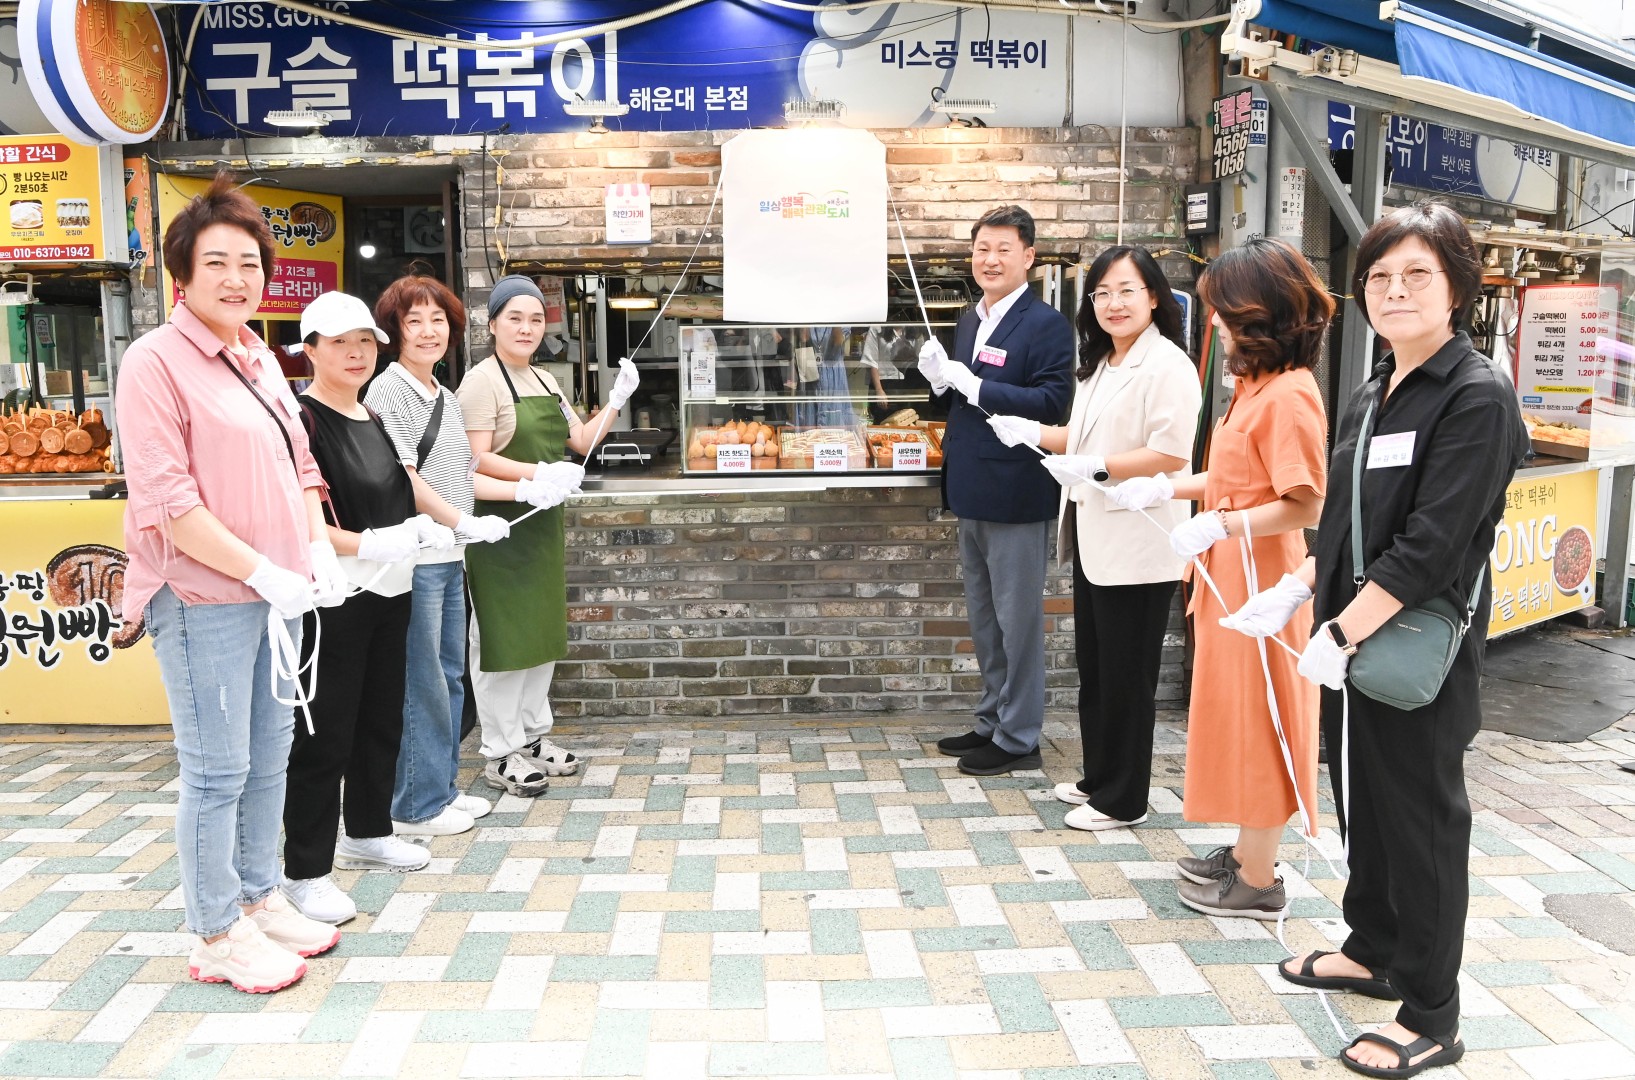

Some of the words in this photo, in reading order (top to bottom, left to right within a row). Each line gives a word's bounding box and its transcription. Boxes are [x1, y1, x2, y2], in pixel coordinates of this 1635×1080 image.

[882, 40, 958, 69] 미스공
[970, 39, 1047, 69] 떡볶이
[206, 37, 357, 124] 구슬
[392, 30, 618, 119] 떡볶이
[629, 86, 695, 111] 해운대
[704, 86, 748, 111] 본점
[1252, 119, 1264, 131] 01
[1213, 130, 1249, 157] 4566
[1442, 128, 1457, 147] 마약
[1459, 130, 1473, 149] 김밥
[0, 146, 20, 162] 할
[26, 146, 56, 160] 간식
[1213, 151, 1246, 178] 1058
[1513, 144, 1535, 161] 해운대
[1537, 148, 1552, 167] 본점
[1441, 154, 1456, 173] 부산
[1457, 158, 1471, 176] 어묵
[13, 172, 22, 183] 빵
[24, 170, 68, 182] 나오는시간
[14, 183, 49, 194] 2분50초
[65, 229, 83, 237] 오징어
[266, 219, 322, 247] 원빵
[13, 246, 91, 258] 010-6370-1942
[286, 266, 316, 278] 치즈를
[1532, 312, 1567, 320] 구슬떡볶이
[1545, 326, 1566, 334] 떡볶이
[898, 447, 922, 455] 새우핫바
[1528, 482, 1557, 507] 떡볶이
[1518, 570, 1553, 614] 떡볶이
[0, 601, 121, 667] 원빵
